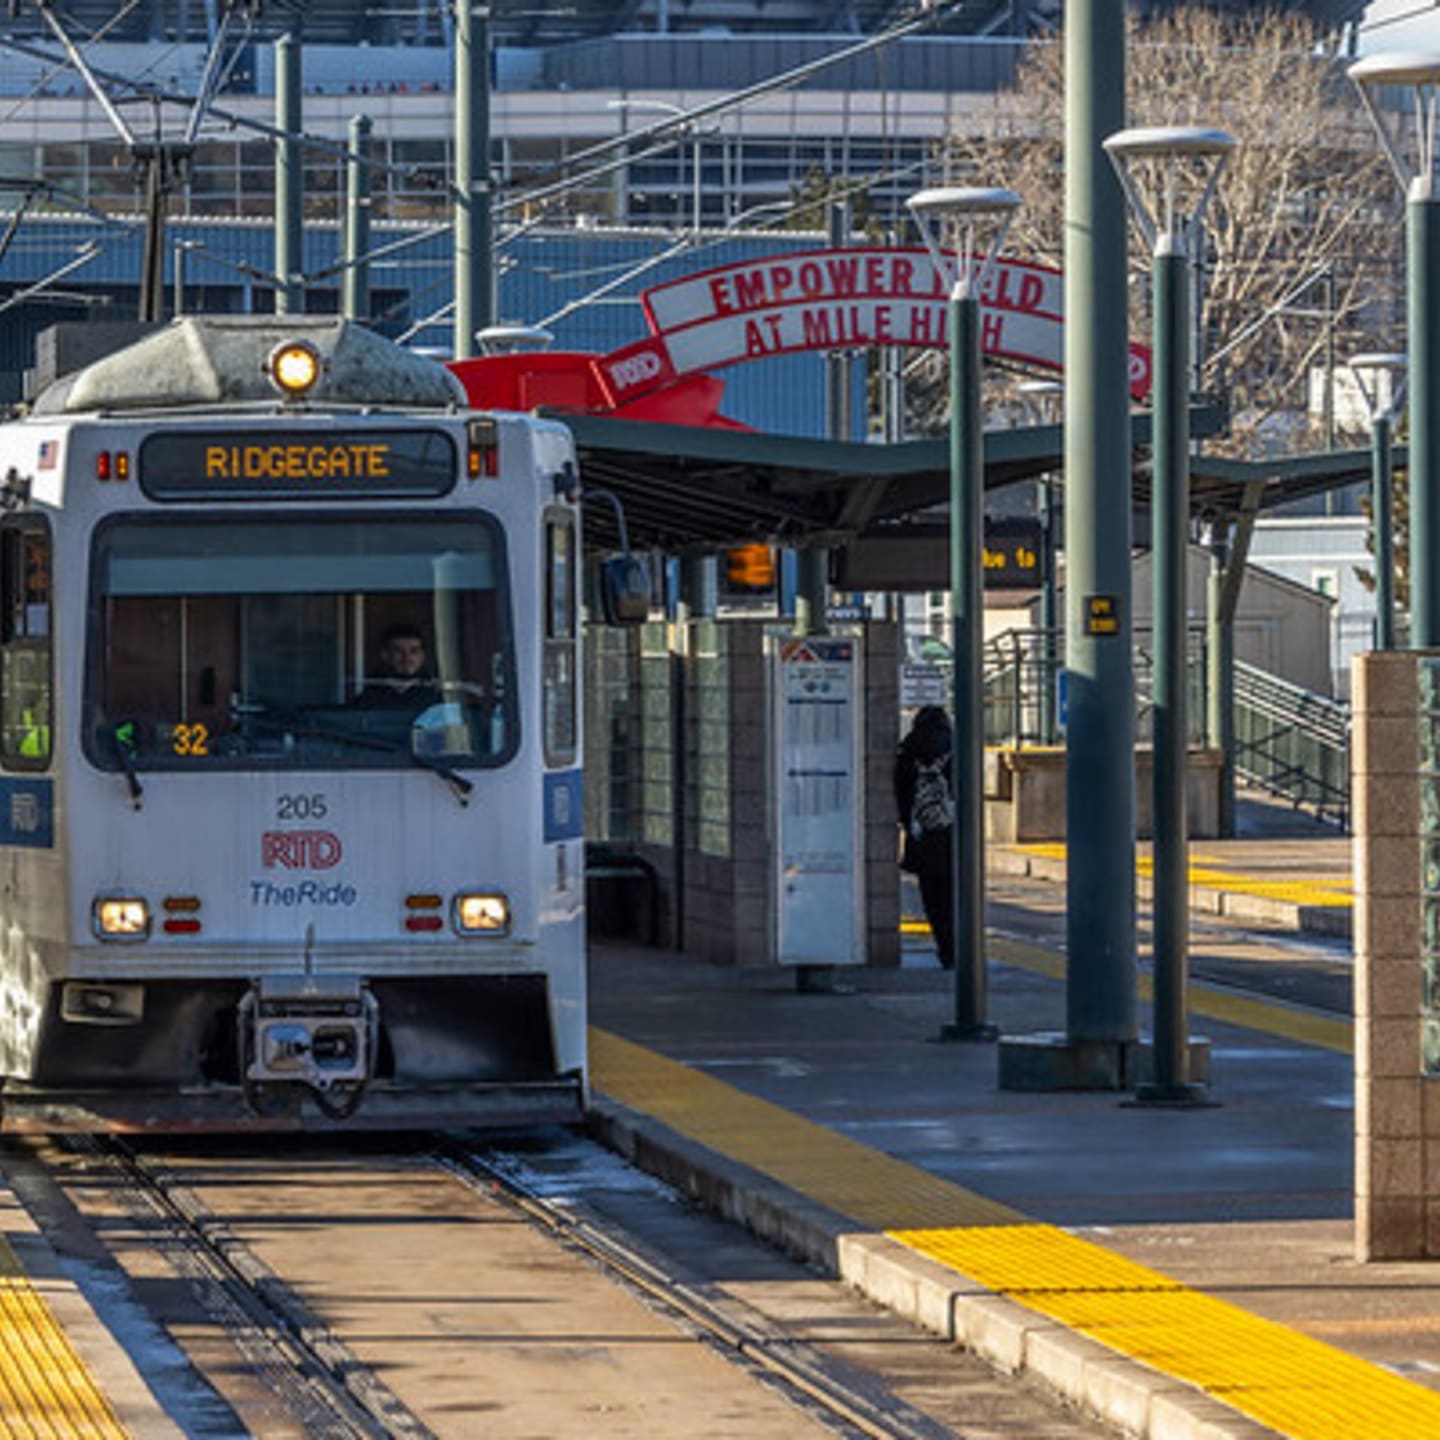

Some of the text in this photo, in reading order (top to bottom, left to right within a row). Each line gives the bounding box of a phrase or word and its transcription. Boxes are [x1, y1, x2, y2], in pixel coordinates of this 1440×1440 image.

[709, 256, 914, 317] EMPOWER
[746, 304, 1005, 355] AT MILE HIH
[206, 444, 390, 478] RIDGEGATE
[173, 723, 209, 756] 32
[276, 794, 328, 820] 205
[262, 830, 342, 870] RTD
